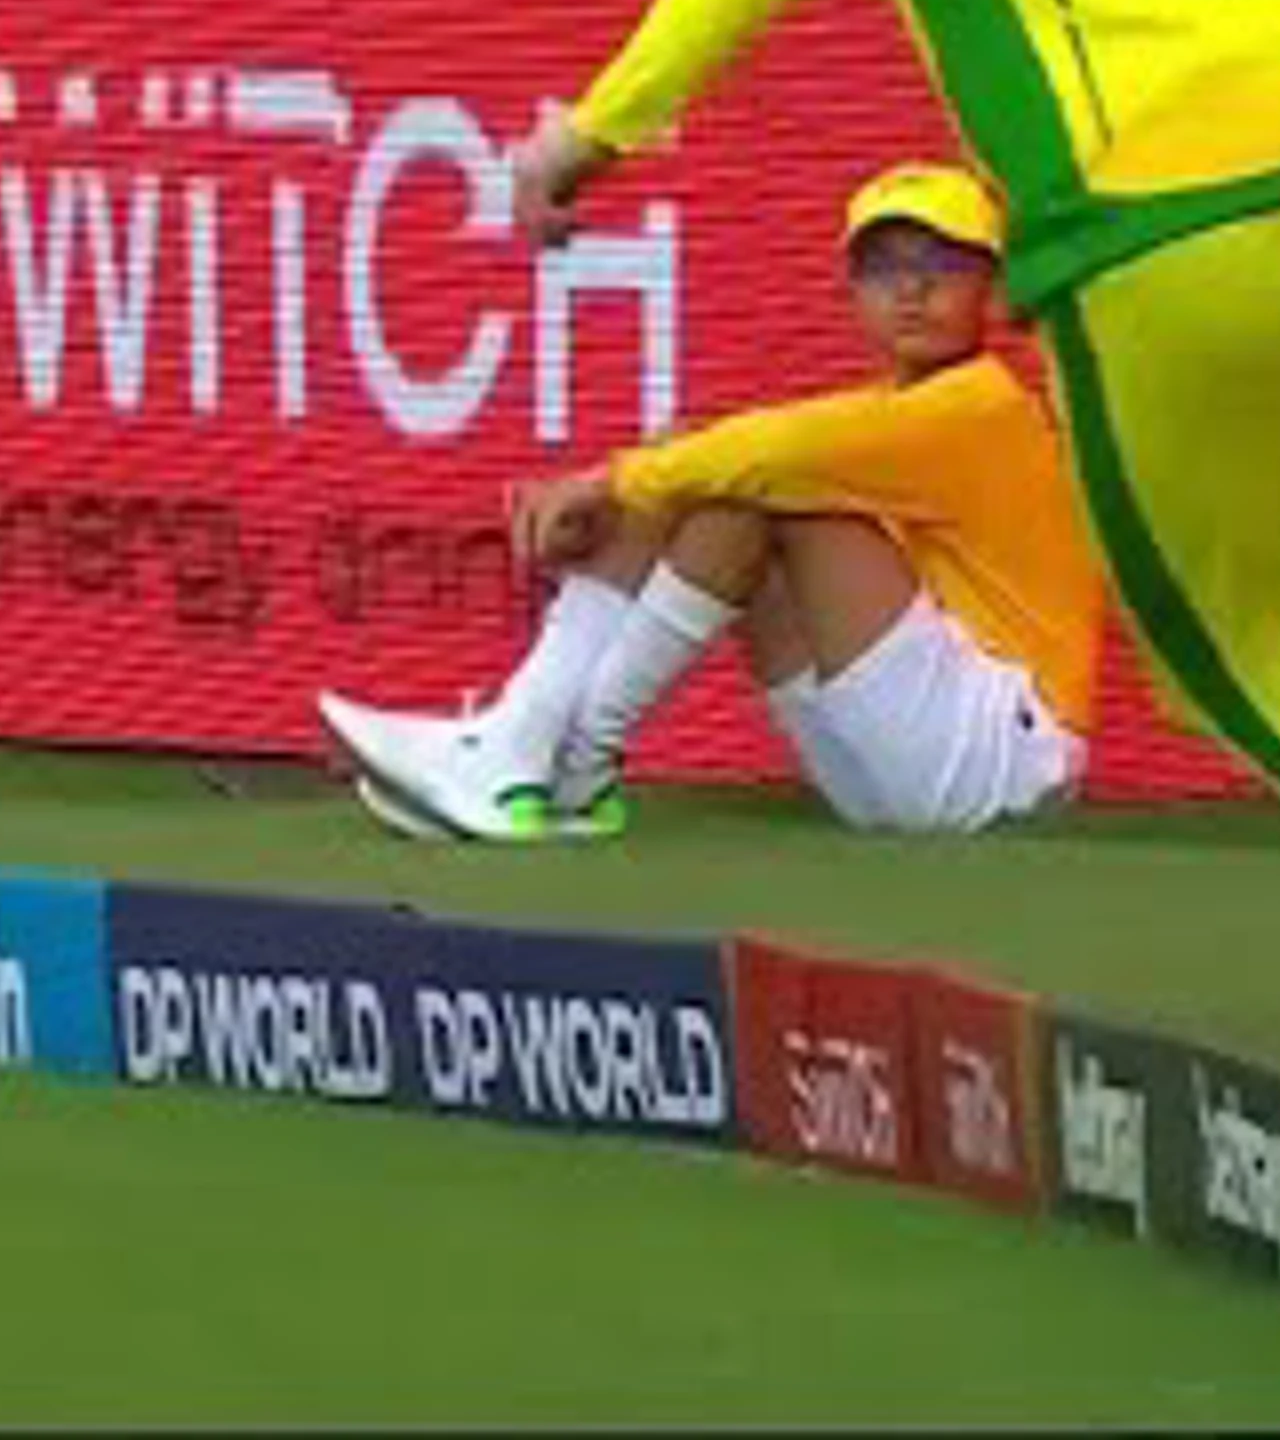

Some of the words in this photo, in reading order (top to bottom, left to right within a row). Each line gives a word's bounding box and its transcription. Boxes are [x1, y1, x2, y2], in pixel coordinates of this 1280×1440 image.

[124, 965, 192, 1084] DP
[194, 972, 391, 1100] WORLD
[415, 988, 502, 1105] DP
[508, 990, 726, 1125] WORLD
